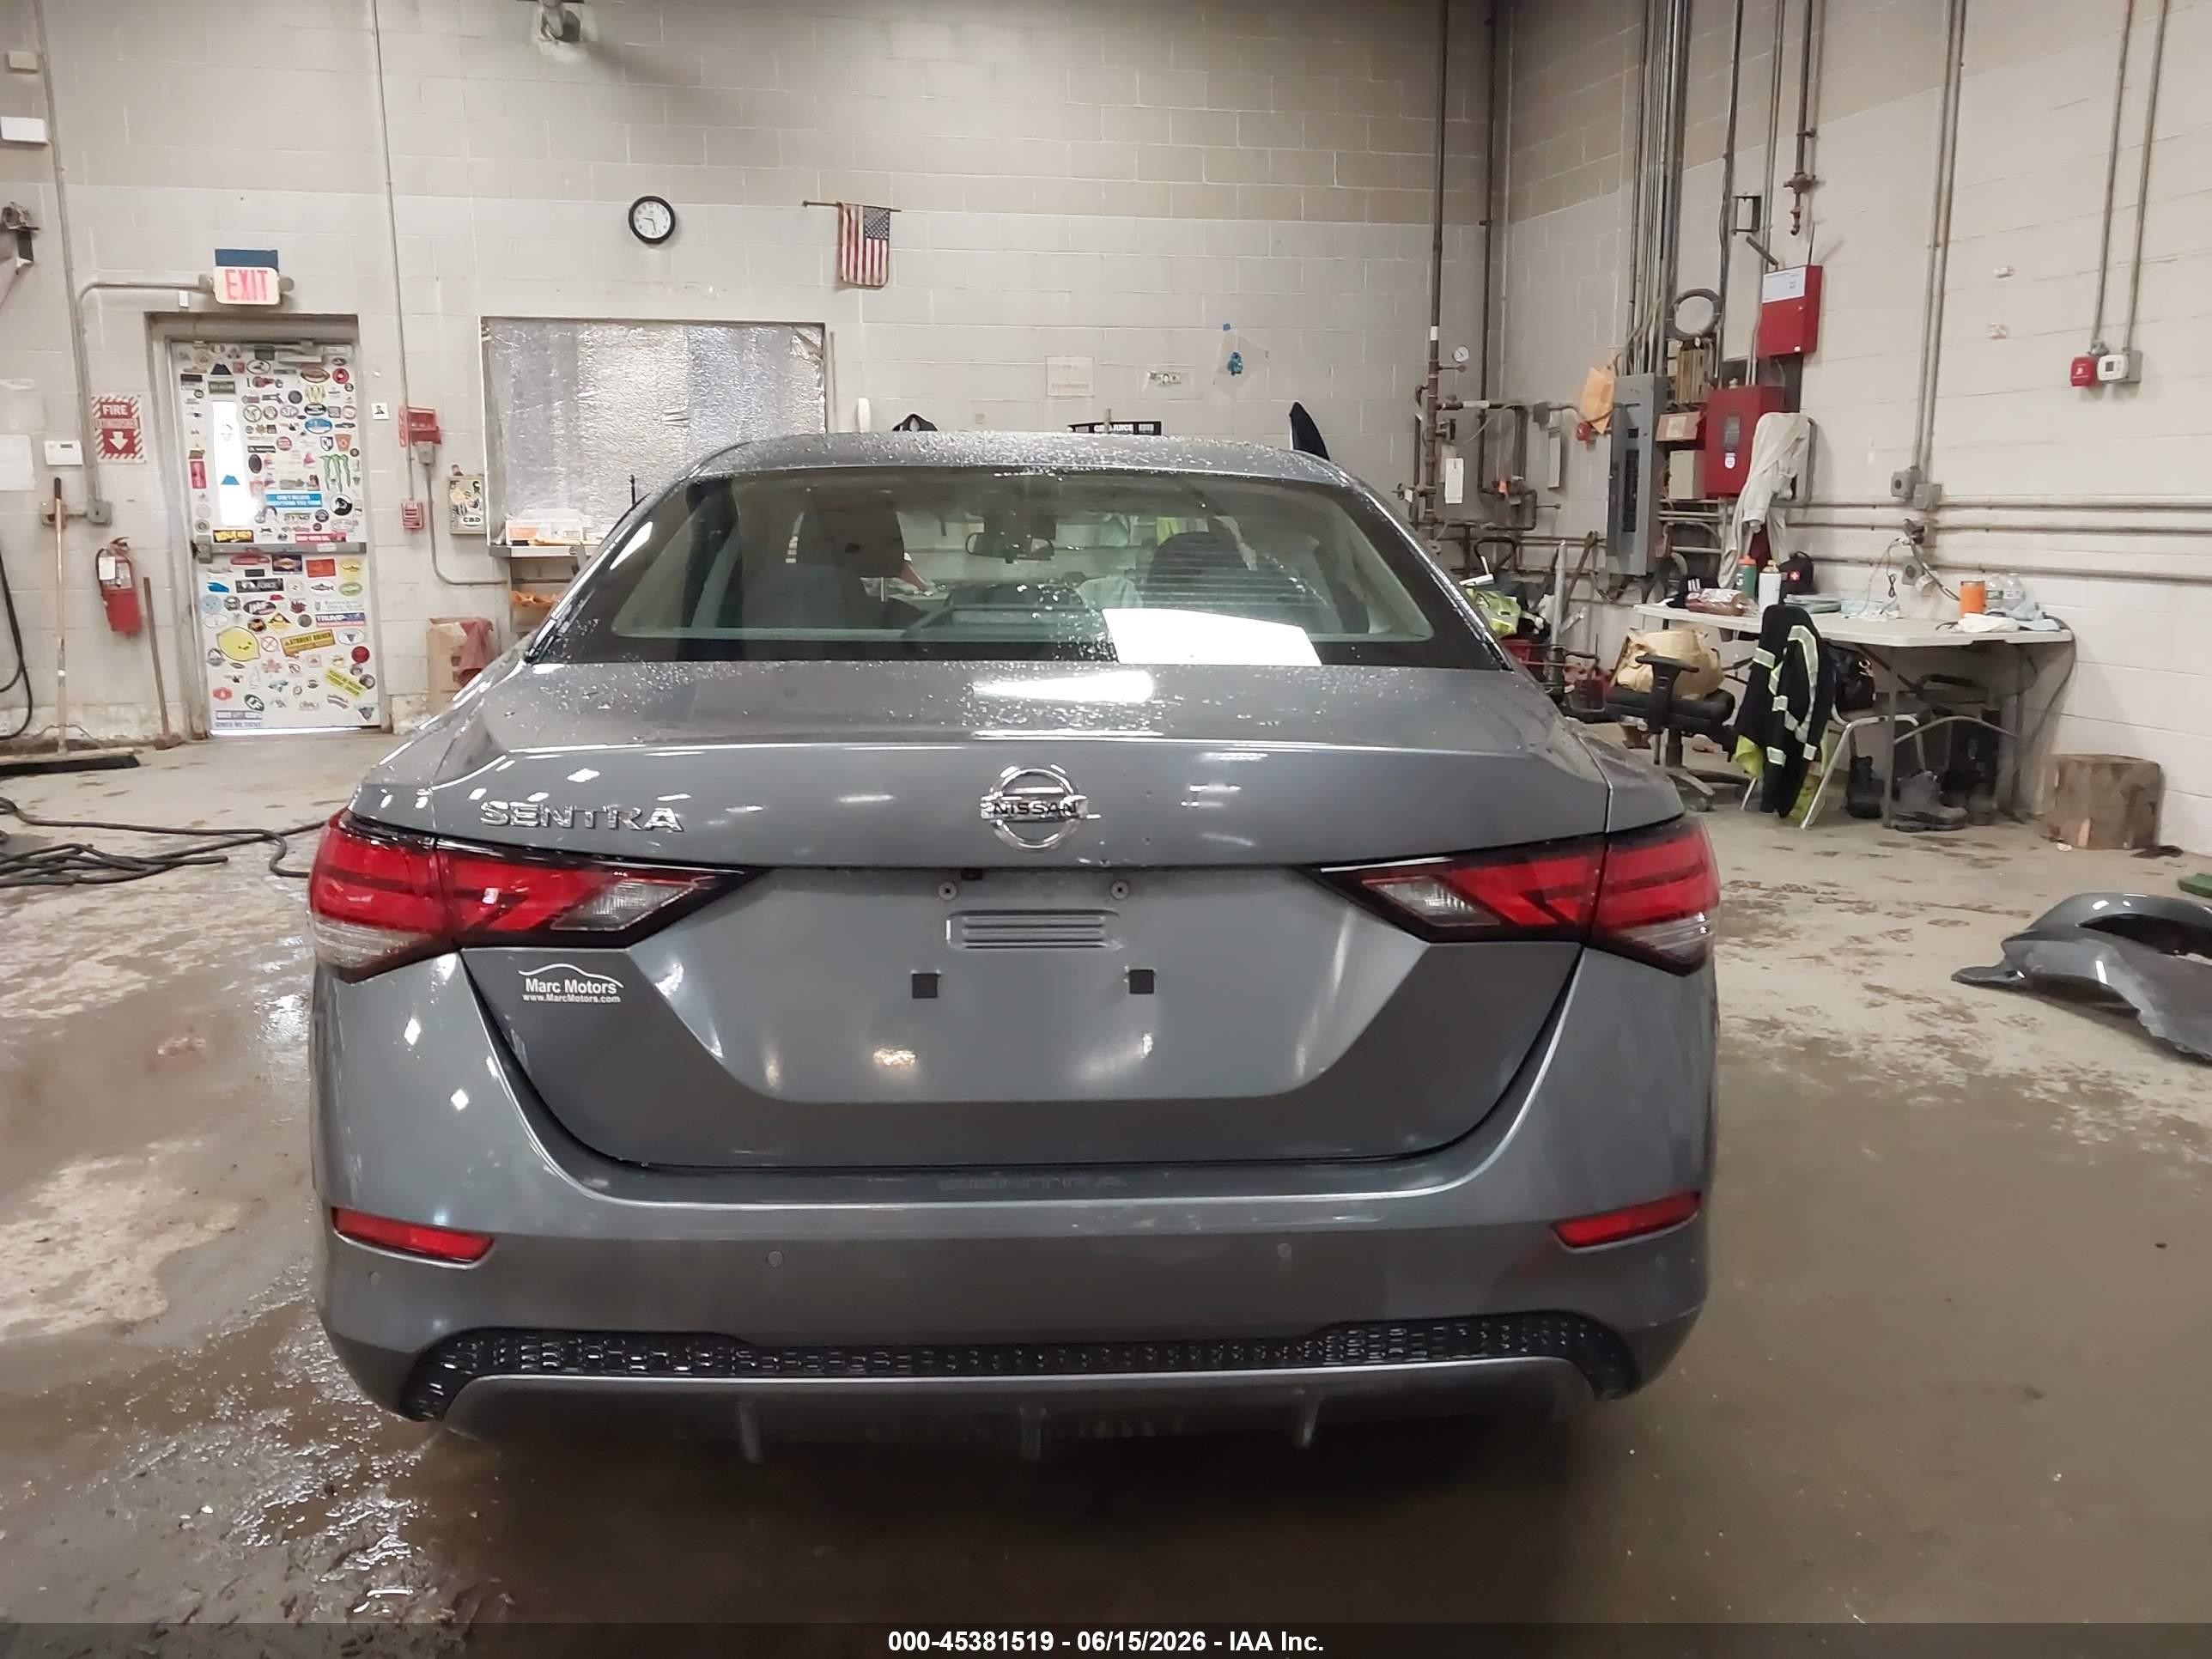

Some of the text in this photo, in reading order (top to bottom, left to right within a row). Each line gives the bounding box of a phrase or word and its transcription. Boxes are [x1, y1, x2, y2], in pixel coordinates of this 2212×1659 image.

[225, 269, 268, 301] EXIT
[102, 404, 128, 416] FIRE
[993, 801, 1078, 815] NISSAN
[480, 800, 684, 832] SENTRA
[526, 978, 617, 994] Marc Motors
[522, 994, 621, 1004] www.MarcMotors.com
